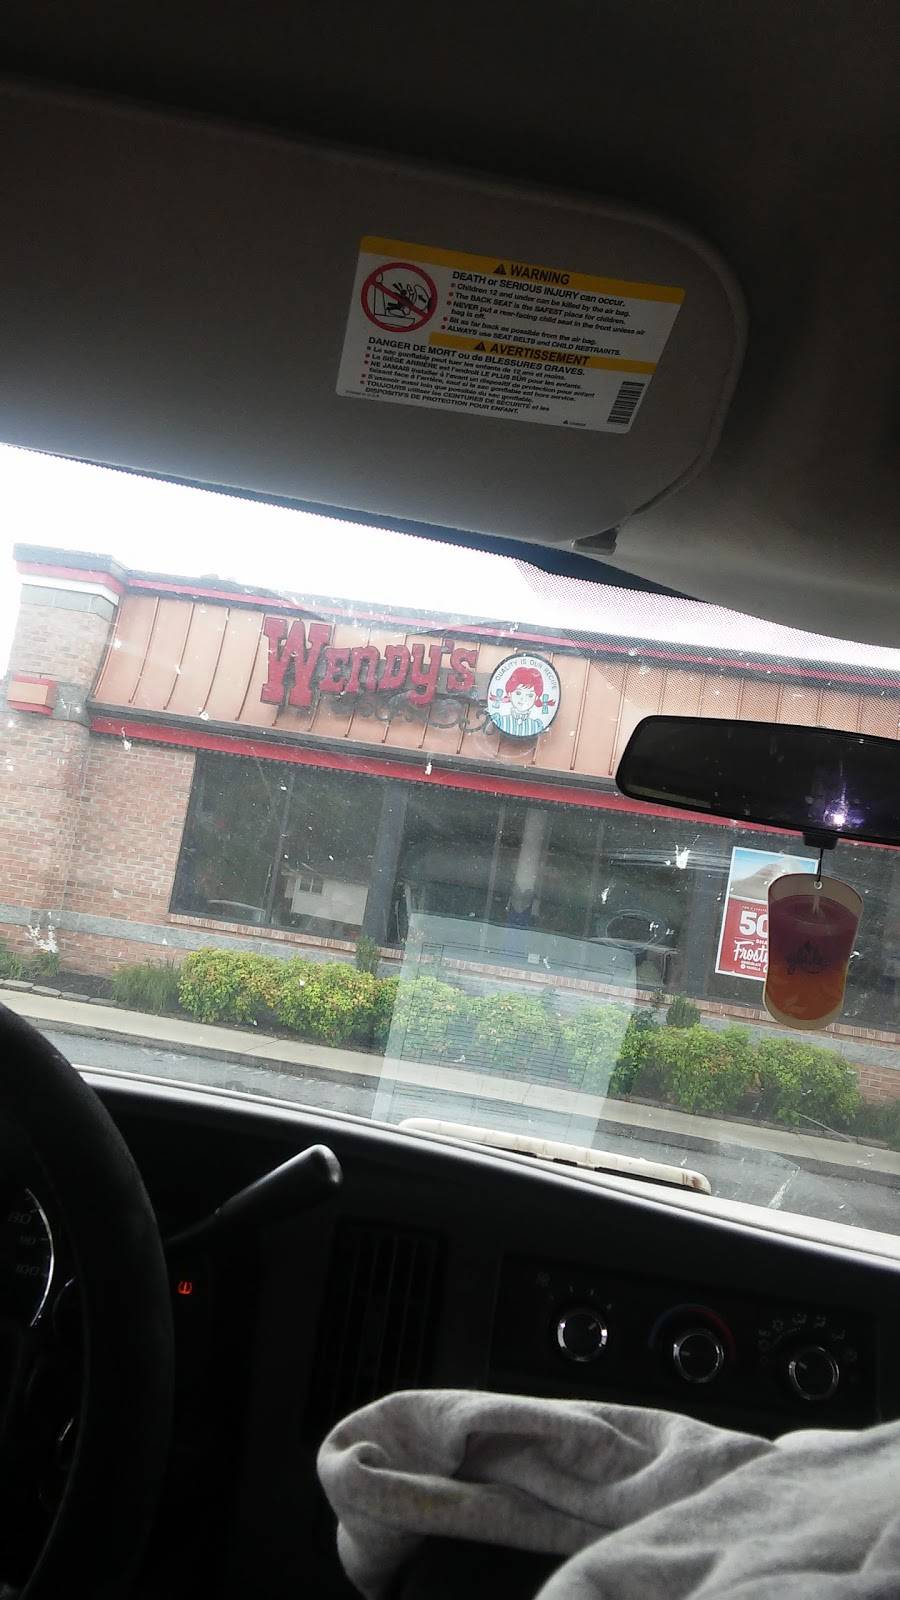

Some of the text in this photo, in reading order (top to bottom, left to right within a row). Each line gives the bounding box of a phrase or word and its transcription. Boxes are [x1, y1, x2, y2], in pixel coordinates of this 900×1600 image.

[509, 264, 570, 284] WARNING
[452, 271, 486, 283] DEATH
[487, 278, 498, 286] or
[498, 279, 542, 293] SERIOUS
[543, 286, 579, 299] INJURY
[579, 294, 596, 302] can
[456, 283, 487, 294] Children
[498, 290, 512, 298] and
[513, 293, 535, 302] under
[561, 301, 580, 309] killed
[450, 308, 464, 316] bag
[452, 301, 478, 310] NEVER
[479, 305, 492, 313] put
[538, 315, 556, 323] child
[594, 323, 611, 331] front
[470, 295, 491, 303] BACK
[493, 298, 512, 307] SEAT
[534, 305, 563, 315] SAFEST
[563, 310, 583, 319] place
[447, 325, 477, 335] ALWAYS
[492, 332, 510, 340] SEAT
[512, 335, 535, 344] BELTS
[551, 341, 574, 349] CHILD
[481, 321, 499, 329] back
[510, 326, 540, 337] possible
[540, 331, 558, 339] from
[368, 336, 411, 349] DANGER
[412, 343, 426, 352] DE
[427, 346, 456, 357] MORT
[471, 353, 483, 361] de
[484, 355, 542, 370] BLESSURES
[543, 363, 586, 376] GRAVES.
[489, 342, 590, 366] AVERTISSEMENT
[382, 362, 409, 371] JAMAIS
[365, 387, 409, 397] DISPOSITIFS
[421, 395, 468, 406] PROTECTION
[366, 380, 406, 390] TOUJOURS
[443, 392, 483, 402] CEINTURES
